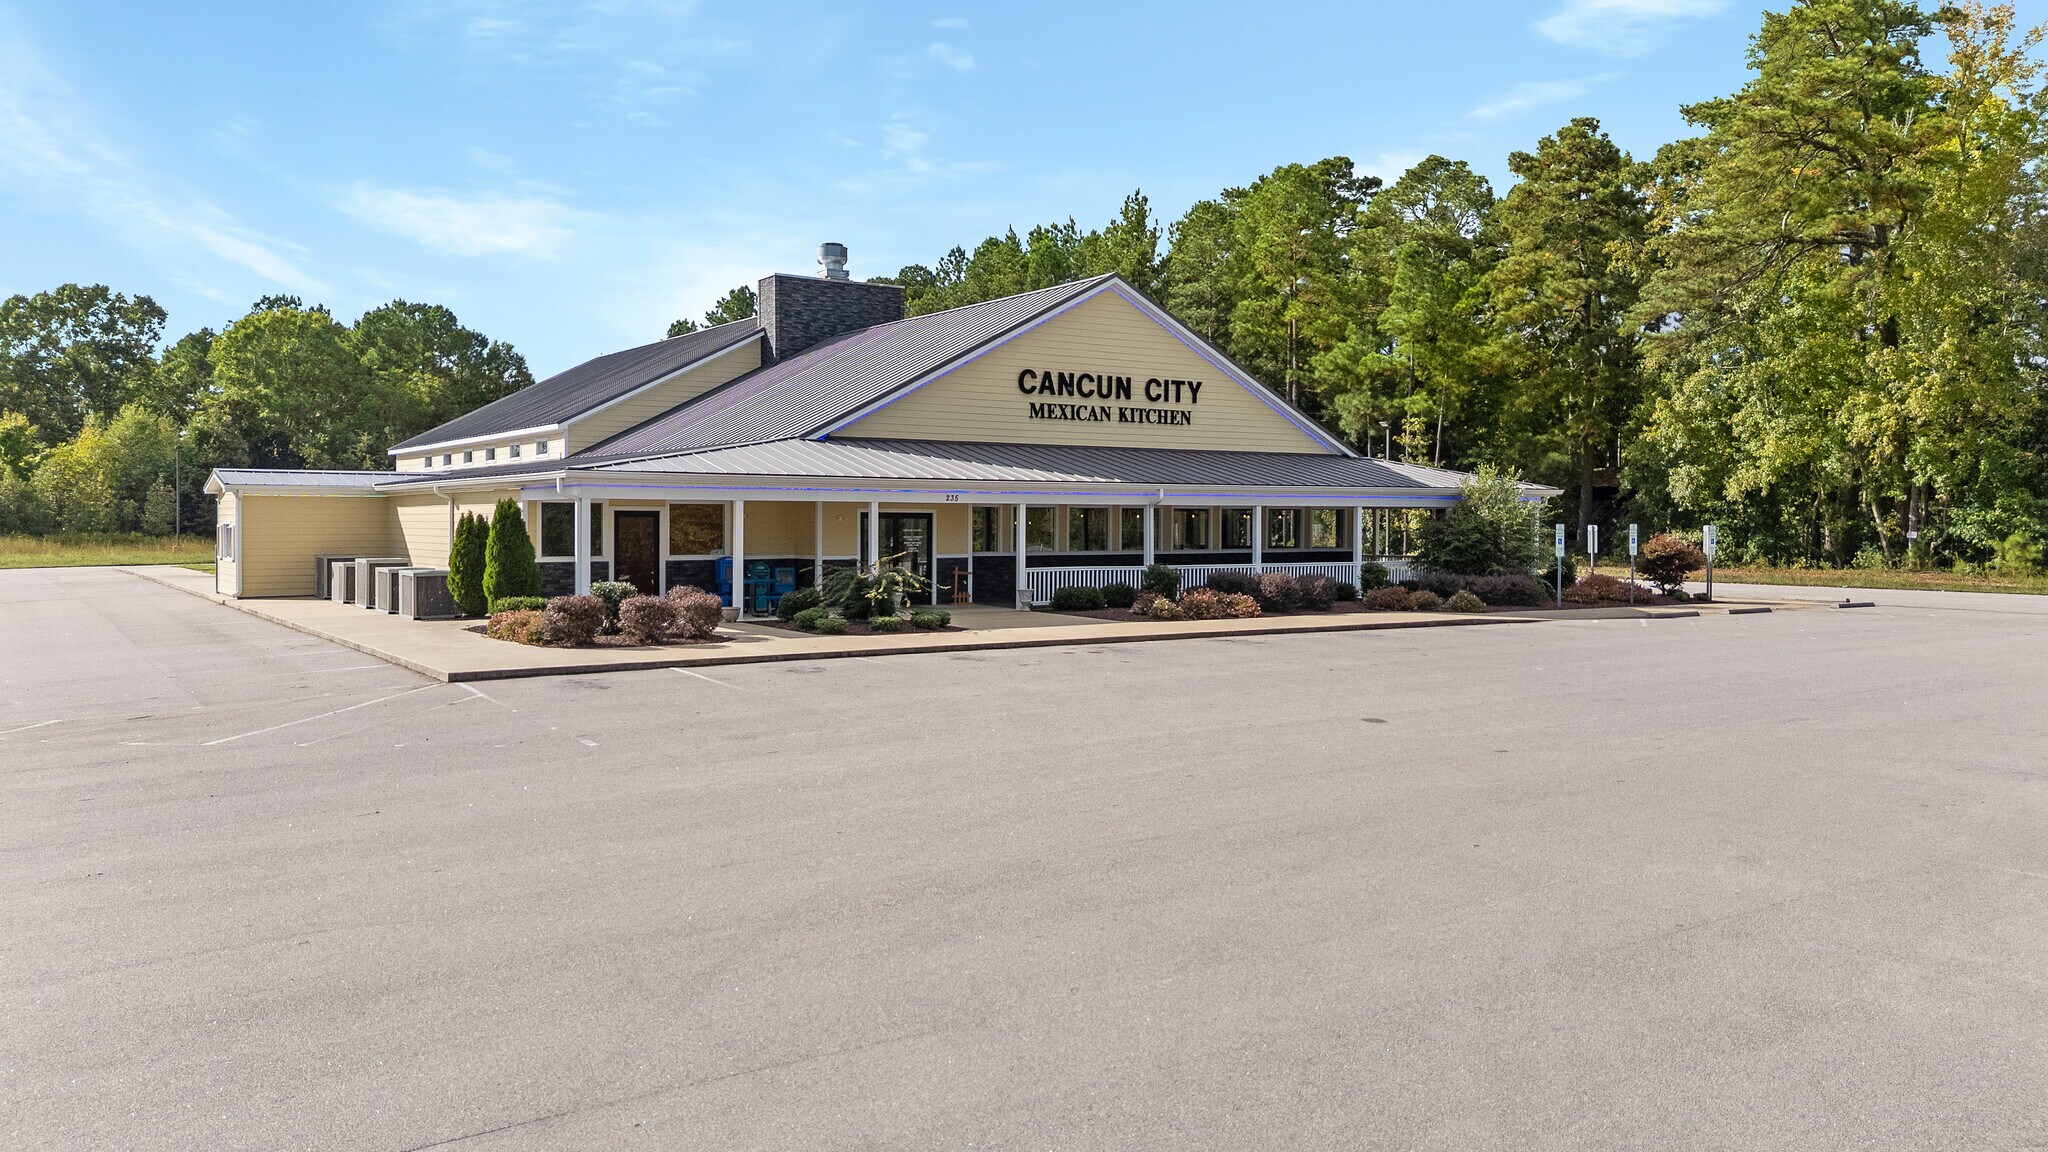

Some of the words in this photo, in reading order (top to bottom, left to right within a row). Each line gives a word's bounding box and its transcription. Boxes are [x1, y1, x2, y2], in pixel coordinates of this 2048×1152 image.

[1018, 369, 1132, 400] CANCUN
[1144, 378, 1203, 404] CITY
[1028, 402, 1112, 422] MEXICAN
[1118, 407, 1192, 426] KITCHEN
[945, 494, 959, 502] 235
